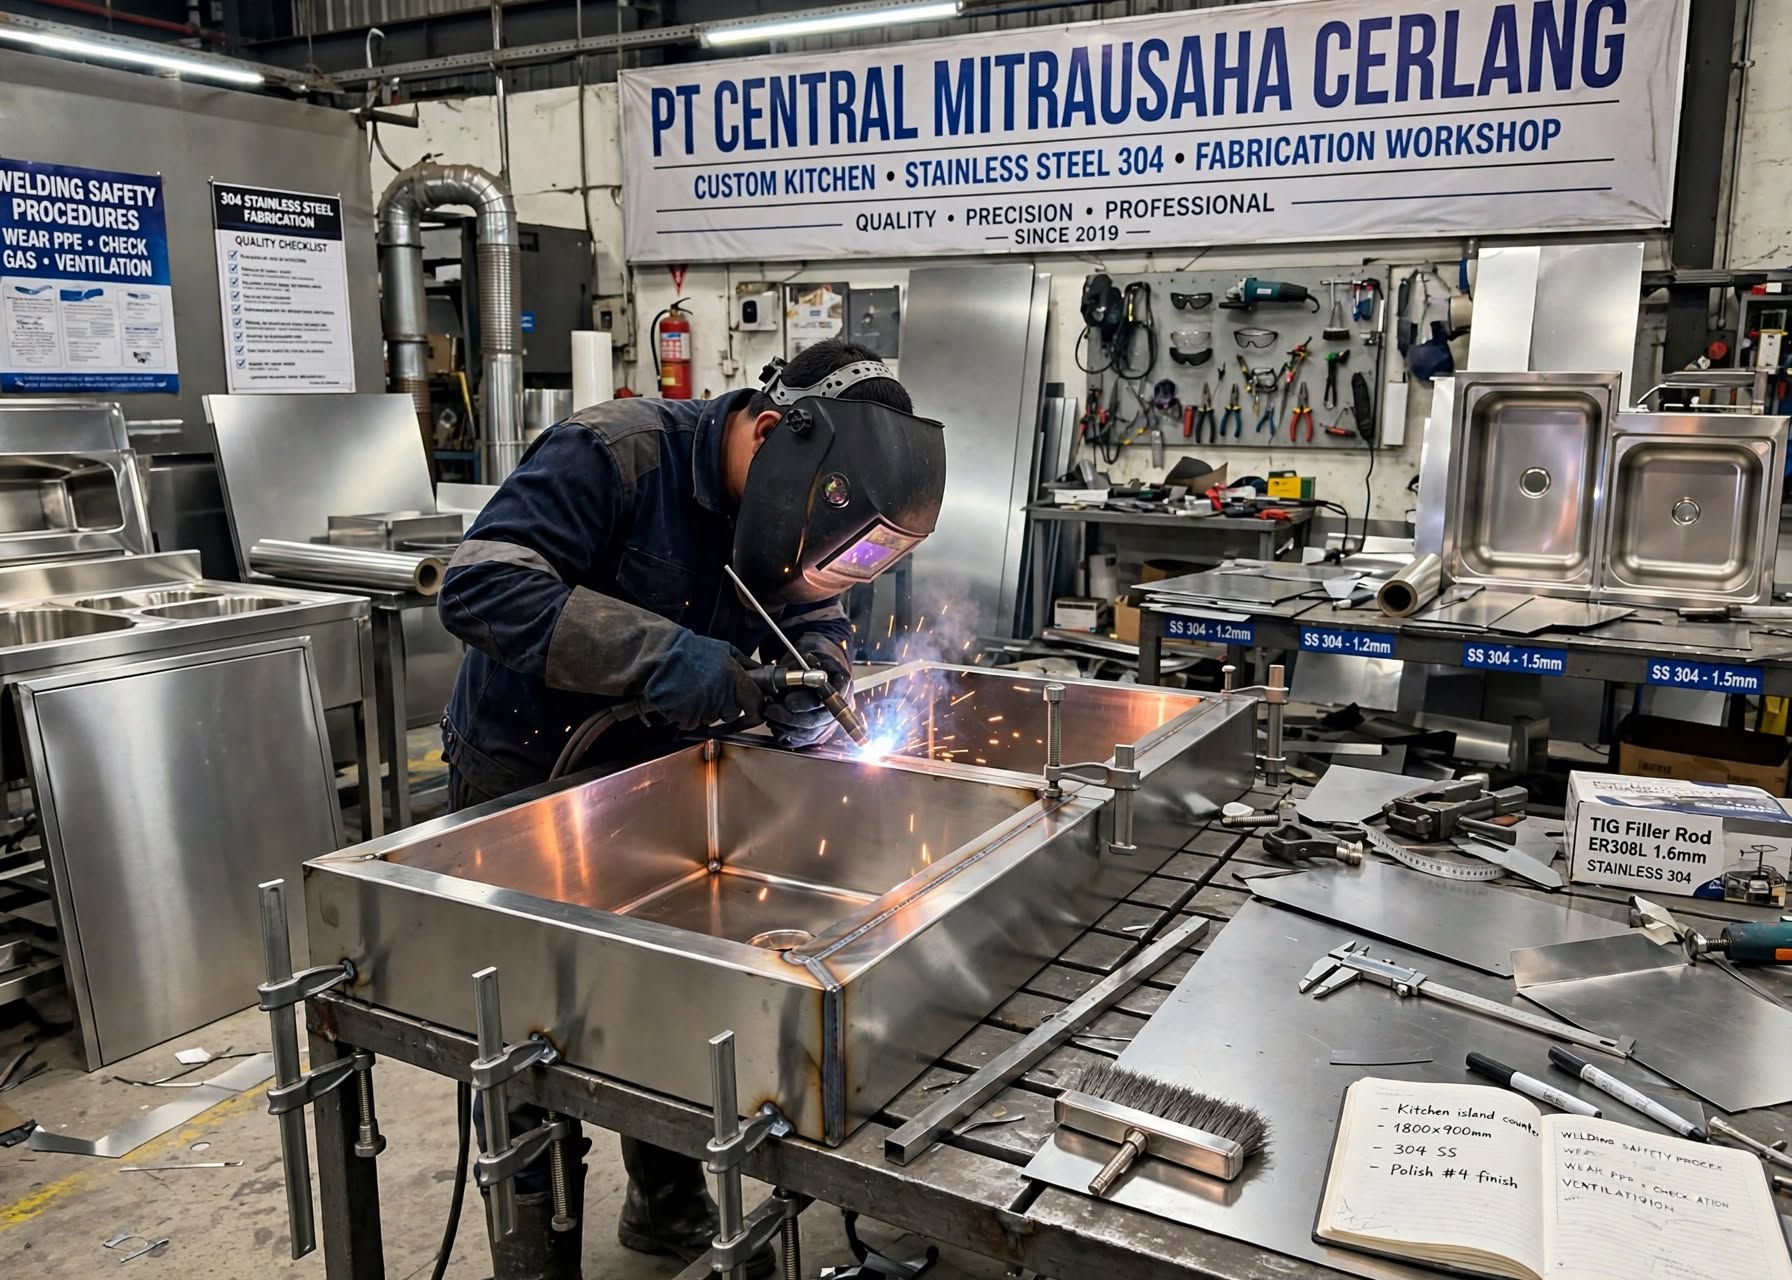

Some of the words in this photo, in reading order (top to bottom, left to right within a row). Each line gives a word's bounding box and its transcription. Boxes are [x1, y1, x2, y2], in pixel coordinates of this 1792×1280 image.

[651, 84, 701, 157] PT
[713, 64, 919, 154] CENTRAL
[933, 26, 1292, 138] MITRAUSAHA
[1312, 0, 1628, 109] CERLANG
[694, 170, 778, 201] CUSTOM
[784, 163, 876, 196] KITCHEN
[905, 153, 1029, 189] STAINLESS
[1036, 148, 1111, 181] STEEL
[1118, 144, 1163, 176] 304
[1195, 130, 1375, 172] FABRICATION
[1385, 118, 1562, 159] WORKSHOP
[0, 169, 84, 200] WELDING
[88, 180, 156, 207] SAFETY
[12, 198, 140, 231] PROCEDURES
[220, 192, 242, 206] 304
[244, 195, 301, 213] STAINLESS
[302, 201, 334, 217] STEEL
[855, 209, 937, 233] QUALITY
[965, 203, 1074, 226] PRECISION
[1105, 192, 1275, 220] PROFESSIONAL
[243, 209, 315, 229] FABRICATION
[2, 227, 50, 249] WEAR
[53, 231, 83, 251] PPE
[99, 234, 148, 256] CHECK
[235, 235, 277, 249] QUALITY
[279, 240, 328, 253] CHECKLIST
[1014, 227, 1070, 245] SINCE
[1075, 225, 1120, 243] 2019
[2, 249, 37, 270] GAS
[55, 253, 153, 277] VENTILATION
[1169, 620, 1184, 634] SS
[1186, 621, 1206, 636] 304
[1216, 624, 1251, 640] 1.2mm
[1304, 632, 1319, 647] SS
[1322, 634, 1342, 649] 304
[1353, 637, 1391, 654] 1.2mm
[1467, 647, 1484, 663] SS
[1488, 650, 1511, 666] 304
[1521, 652, 1562, 671] 1.5mm
[1652, 664, 1670, 681] SS
[1674, 667, 1699, 684] 304
[1712, 670, 1758, 690] 1.5mm
[1590, 817, 1619, 834] TIG
[1626, 821, 1670, 840] Filler
[1675, 827, 1712, 845] Rod
[1588, 837, 1647, 858] ER308L
[1653, 844, 1707, 864] 1.6mm
[1587, 859, 1663, 880] STAINLESS
[1667, 870, 1692, 884] 304
[1397, 1103, 1450, 1116] Kitchen
[1457, 1107, 1495, 1120] island
[1393, 1144, 1427, 1156] 304
[1437, 1146, 1457, 1158] SS
[1390, 1163, 1433, 1177] Polish
[1442, 1168, 1469, 1181] #4
[1476, 1169, 1518, 1189] finish
